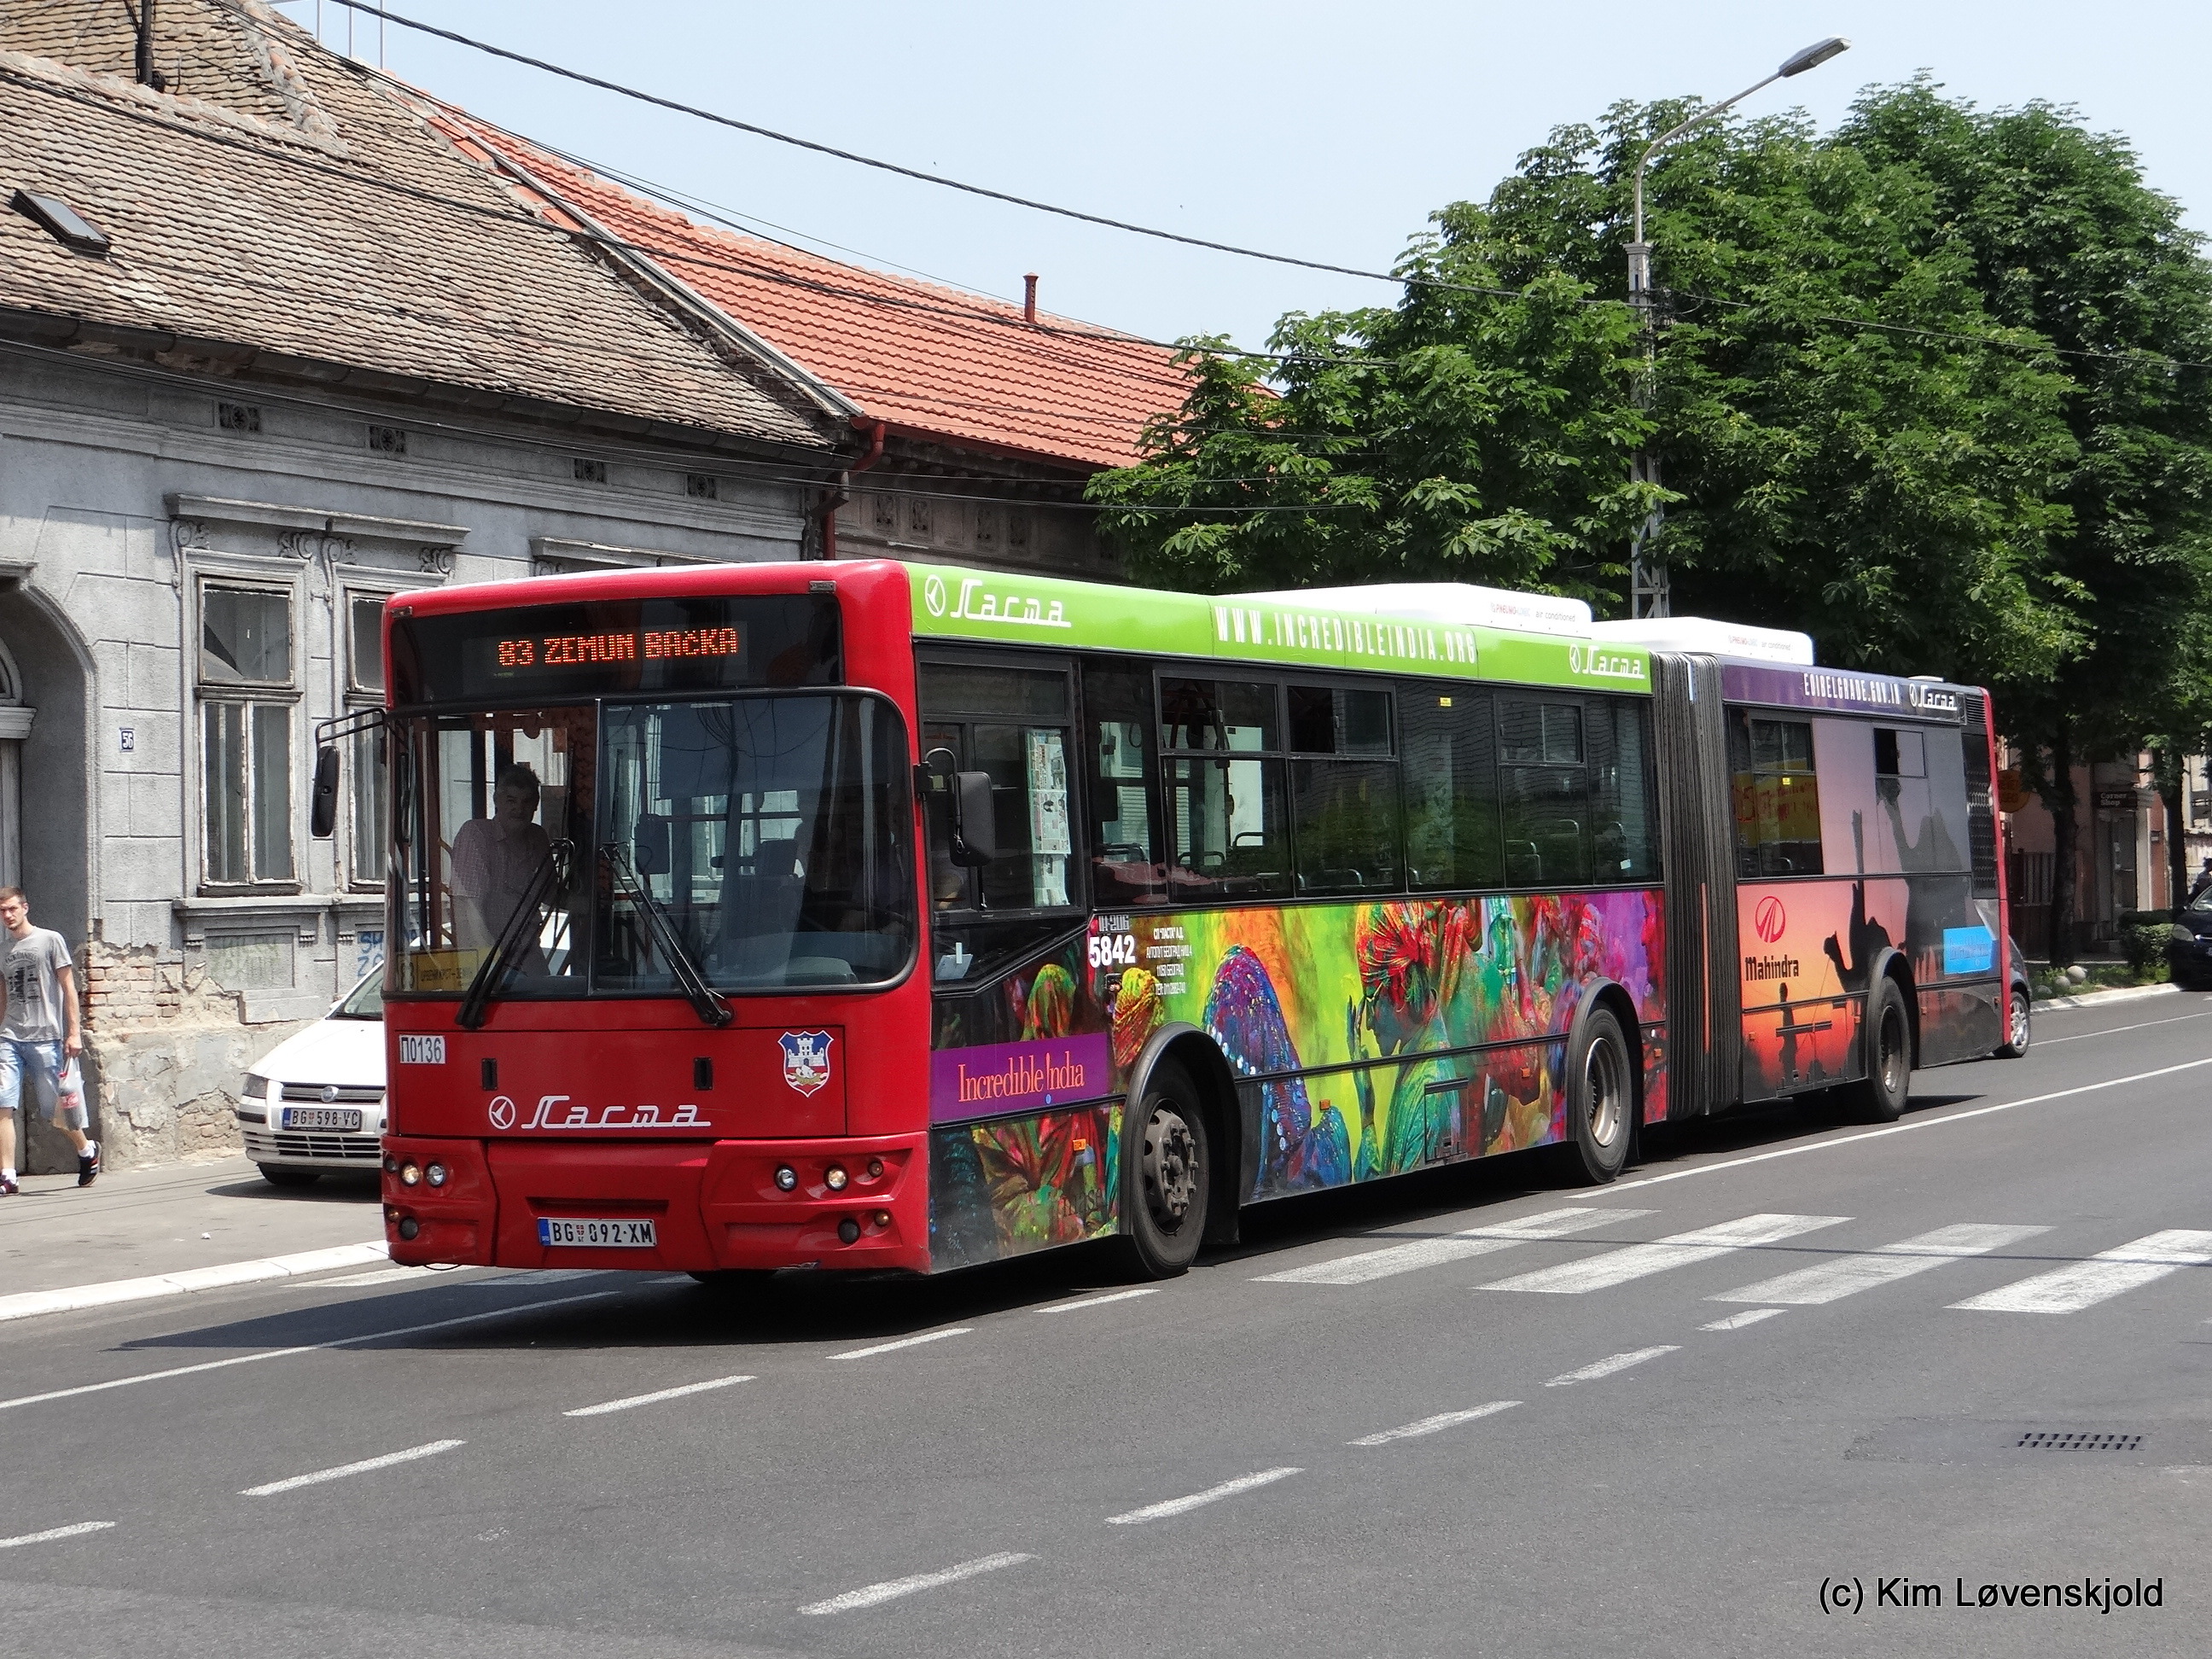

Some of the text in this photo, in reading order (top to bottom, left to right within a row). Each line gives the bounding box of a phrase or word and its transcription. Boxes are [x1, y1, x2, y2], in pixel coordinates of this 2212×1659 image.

[498, 640, 533, 666] 83
[544, 633, 634, 663] ZEMUN
[1214, 605, 1476, 664] WWW.INCREDIBLEINDIA.ORG
[1803, 673, 1901, 705] EOIBELGRADE.GOV.IN
[122, 732, 133, 748] 56
[1089, 934, 1136, 968] 5842
[1745, 954, 1799, 981] Mahindra
[958, 1055, 1044, 1103] Incredible
[293, 1110, 307, 1124] BG
[552, 1222, 573, 1243] BG
